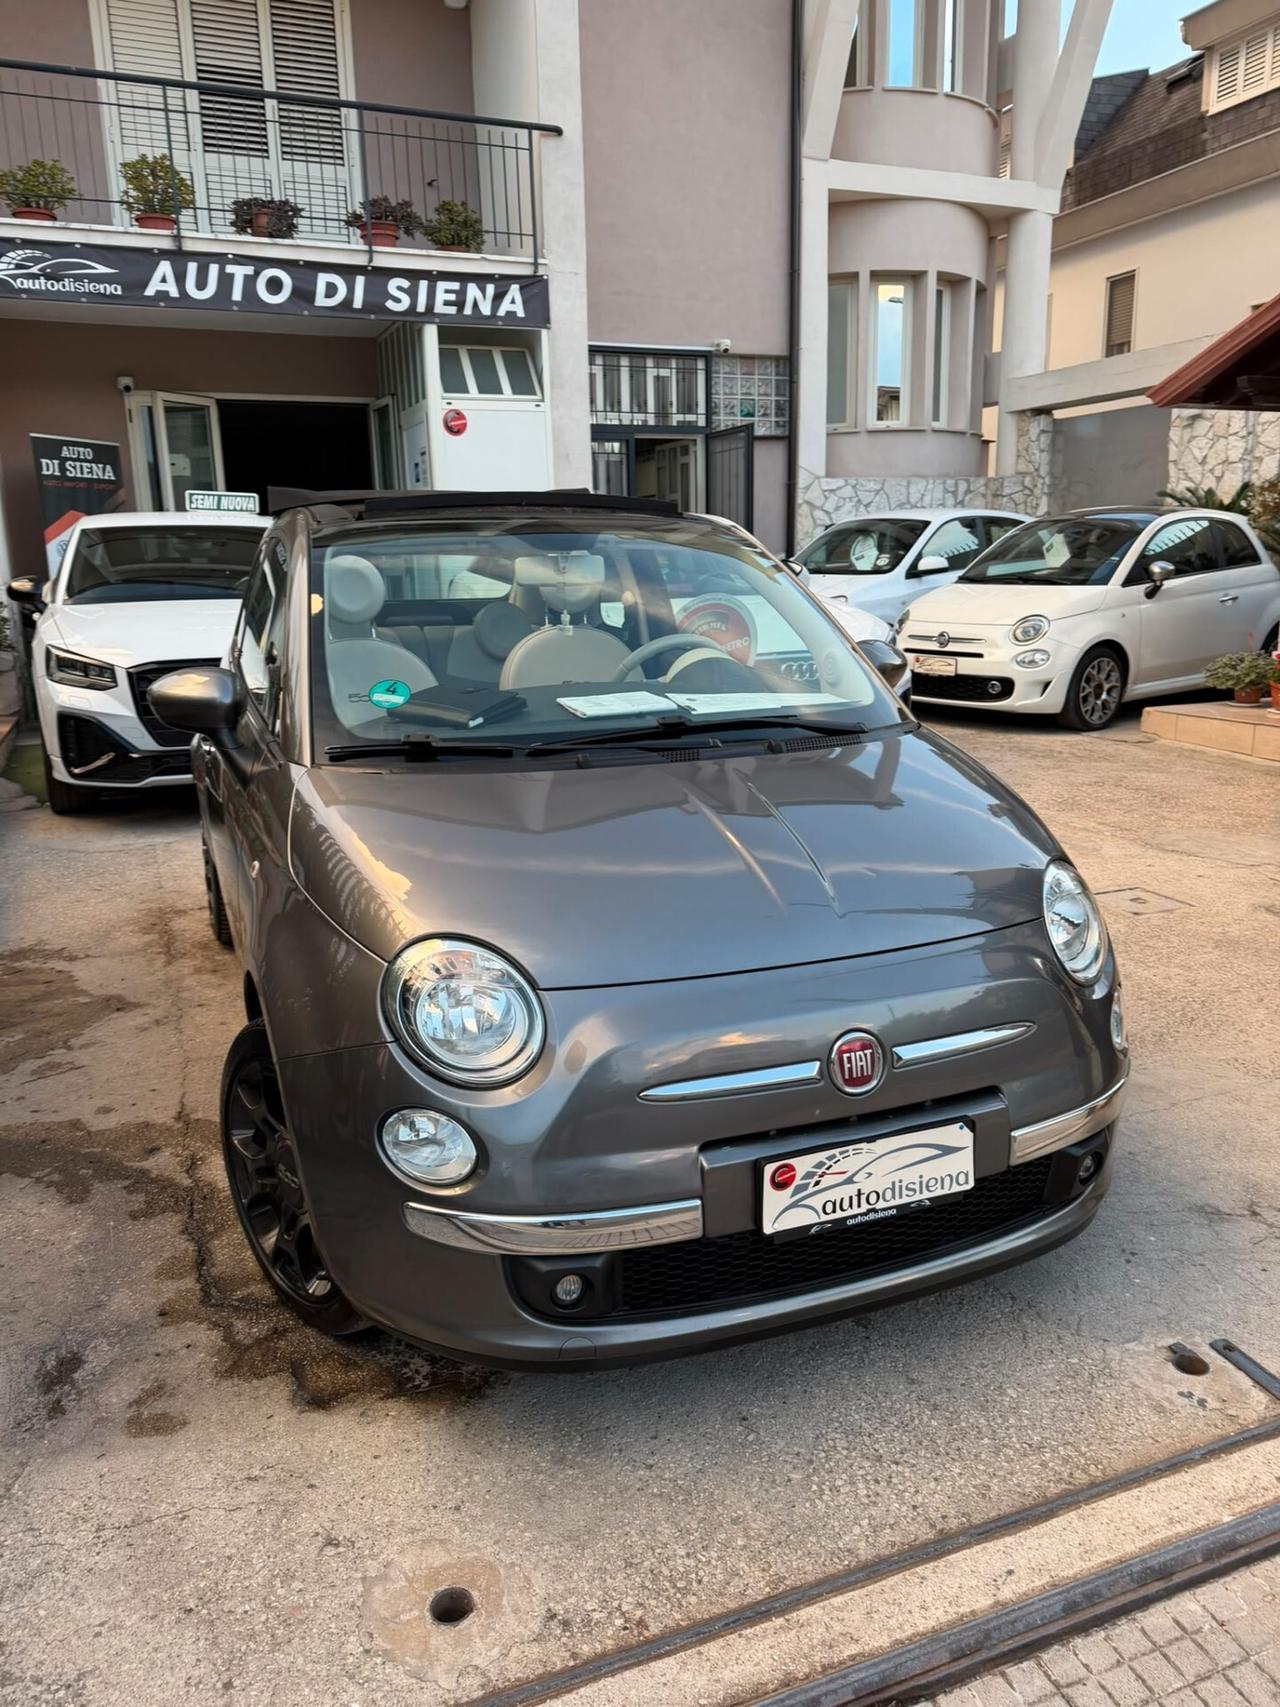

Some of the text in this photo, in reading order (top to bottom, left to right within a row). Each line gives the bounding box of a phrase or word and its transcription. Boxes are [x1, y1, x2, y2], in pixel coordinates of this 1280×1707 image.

[16, 276, 122, 295] autodisiena
[144, 260, 526, 317] AUTO DI SIENA
[61, 446, 93, 459] AUTO
[40, 459, 116, 480] DI SIENA
[191, 495, 255, 511] SEMI NUOVA
[385, 682, 398, 695] 4
[842, 1049, 873, 1080] FIAT
[822, 1170, 970, 1215] autodisiena
[846, 1208, 897, 1226] autodisiena
